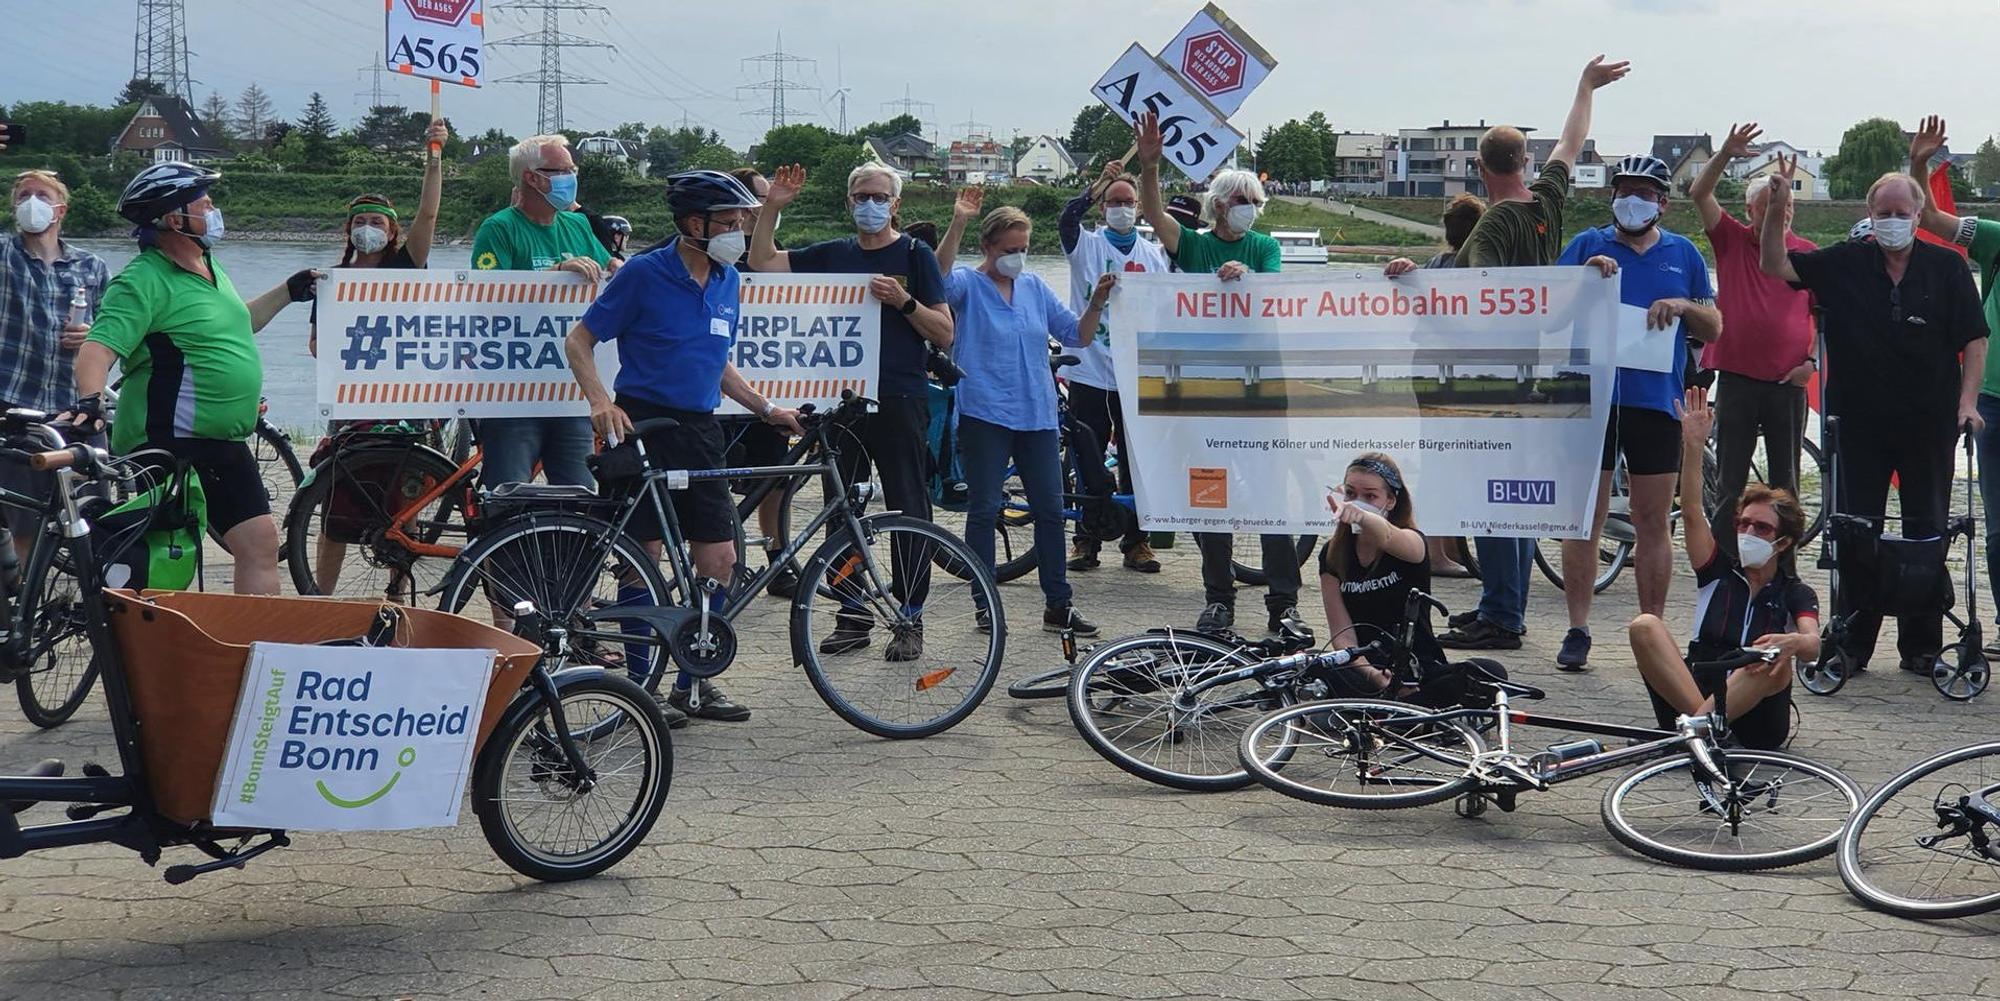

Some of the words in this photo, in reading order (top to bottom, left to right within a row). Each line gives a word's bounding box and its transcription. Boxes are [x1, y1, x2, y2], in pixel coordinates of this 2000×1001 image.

[434, 2, 453, 13] A565
[386, 34, 480, 78] A565
[1205, 40, 1237, 69] STOP
[1098, 72, 1218, 167] A565
[1176, 291, 1251, 318] NEIN
[1262, 296, 1308, 317] zur
[1317, 287, 1468, 317] Autobahn
[1479, 286, 1548, 316] 553!
[395, 315, 583, 338] MEHRPLAT
[736, 315, 862, 338] HRPLATZ
[395, 340, 572, 370] FÜRSRA
[728, 340, 864, 369] RSRAD
[1205, 438, 1269, 451] Vernetzung
[1272, 438, 1306, 449] Kölner
[1310, 438, 1330, 449] und
[1332, 438, 1416, 450] Niederkasseler
[1418, 438, 1512, 452] Bürgerinitiativen
[1492, 481, 1551, 503] BI-UVI
[296, 671, 372, 701] Rad
[287, 704, 469, 737] Entscheid
[240, 668, 287, 804] #BonnSteigtAuf
[278, 740, 379, 771] Bonn
